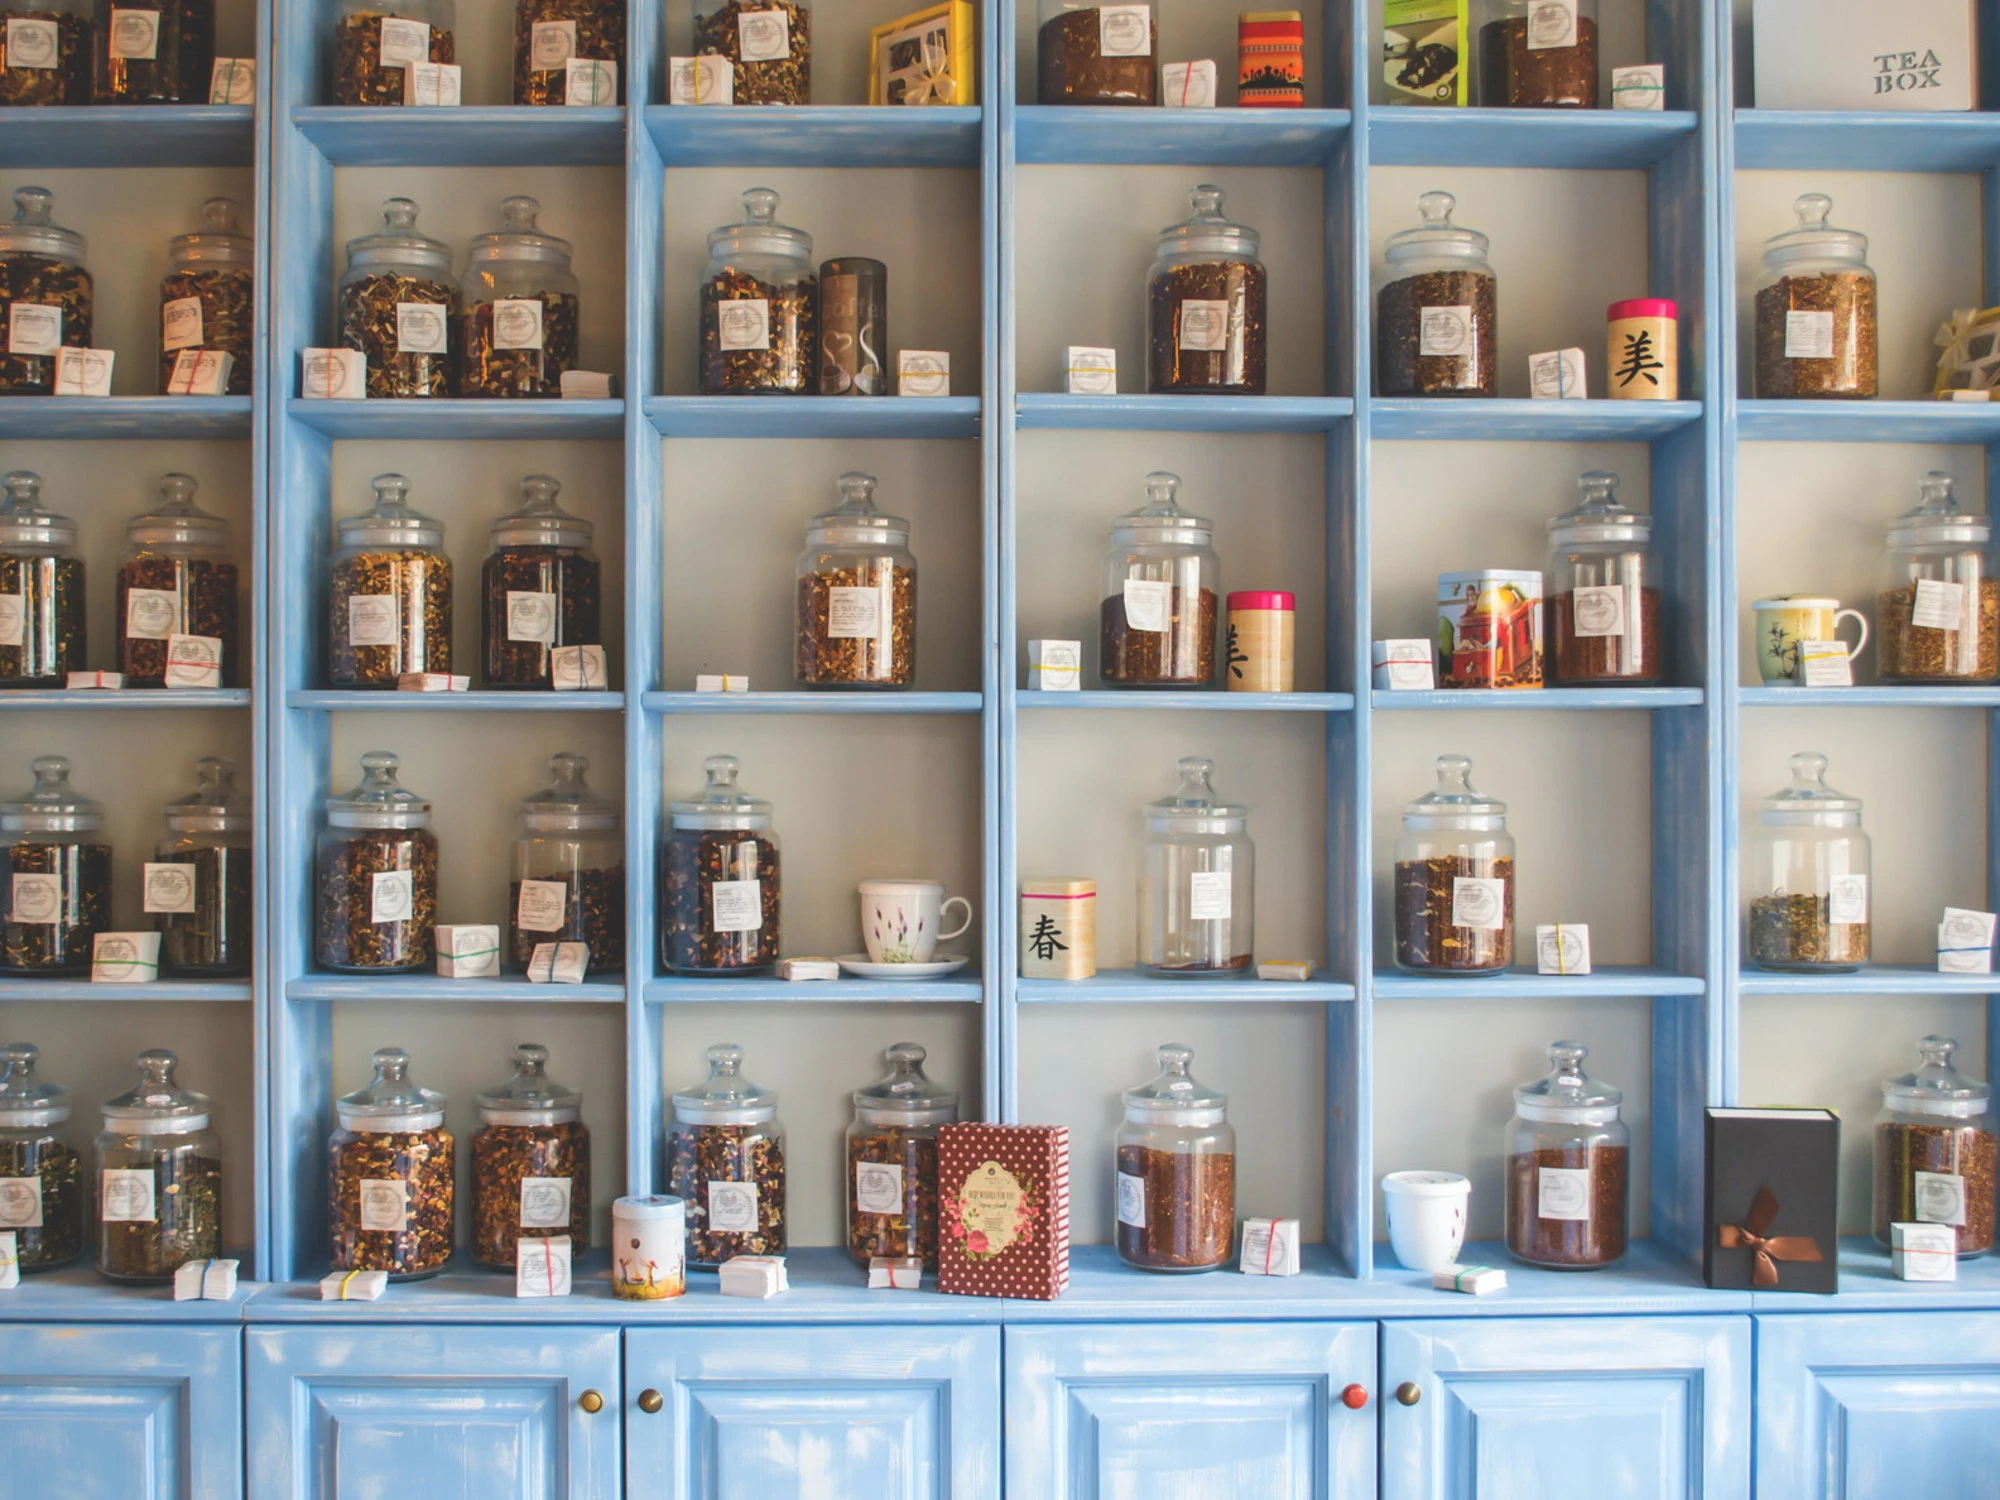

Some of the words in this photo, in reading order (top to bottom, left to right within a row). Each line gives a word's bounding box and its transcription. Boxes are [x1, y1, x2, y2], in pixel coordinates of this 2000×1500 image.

[1873, 48, 1941, 74] TEA
[1873, 69, 1941, 94] BOX
[1615, 330, 1663, 388] 美
[1029, 914, 1069, 960] 春
